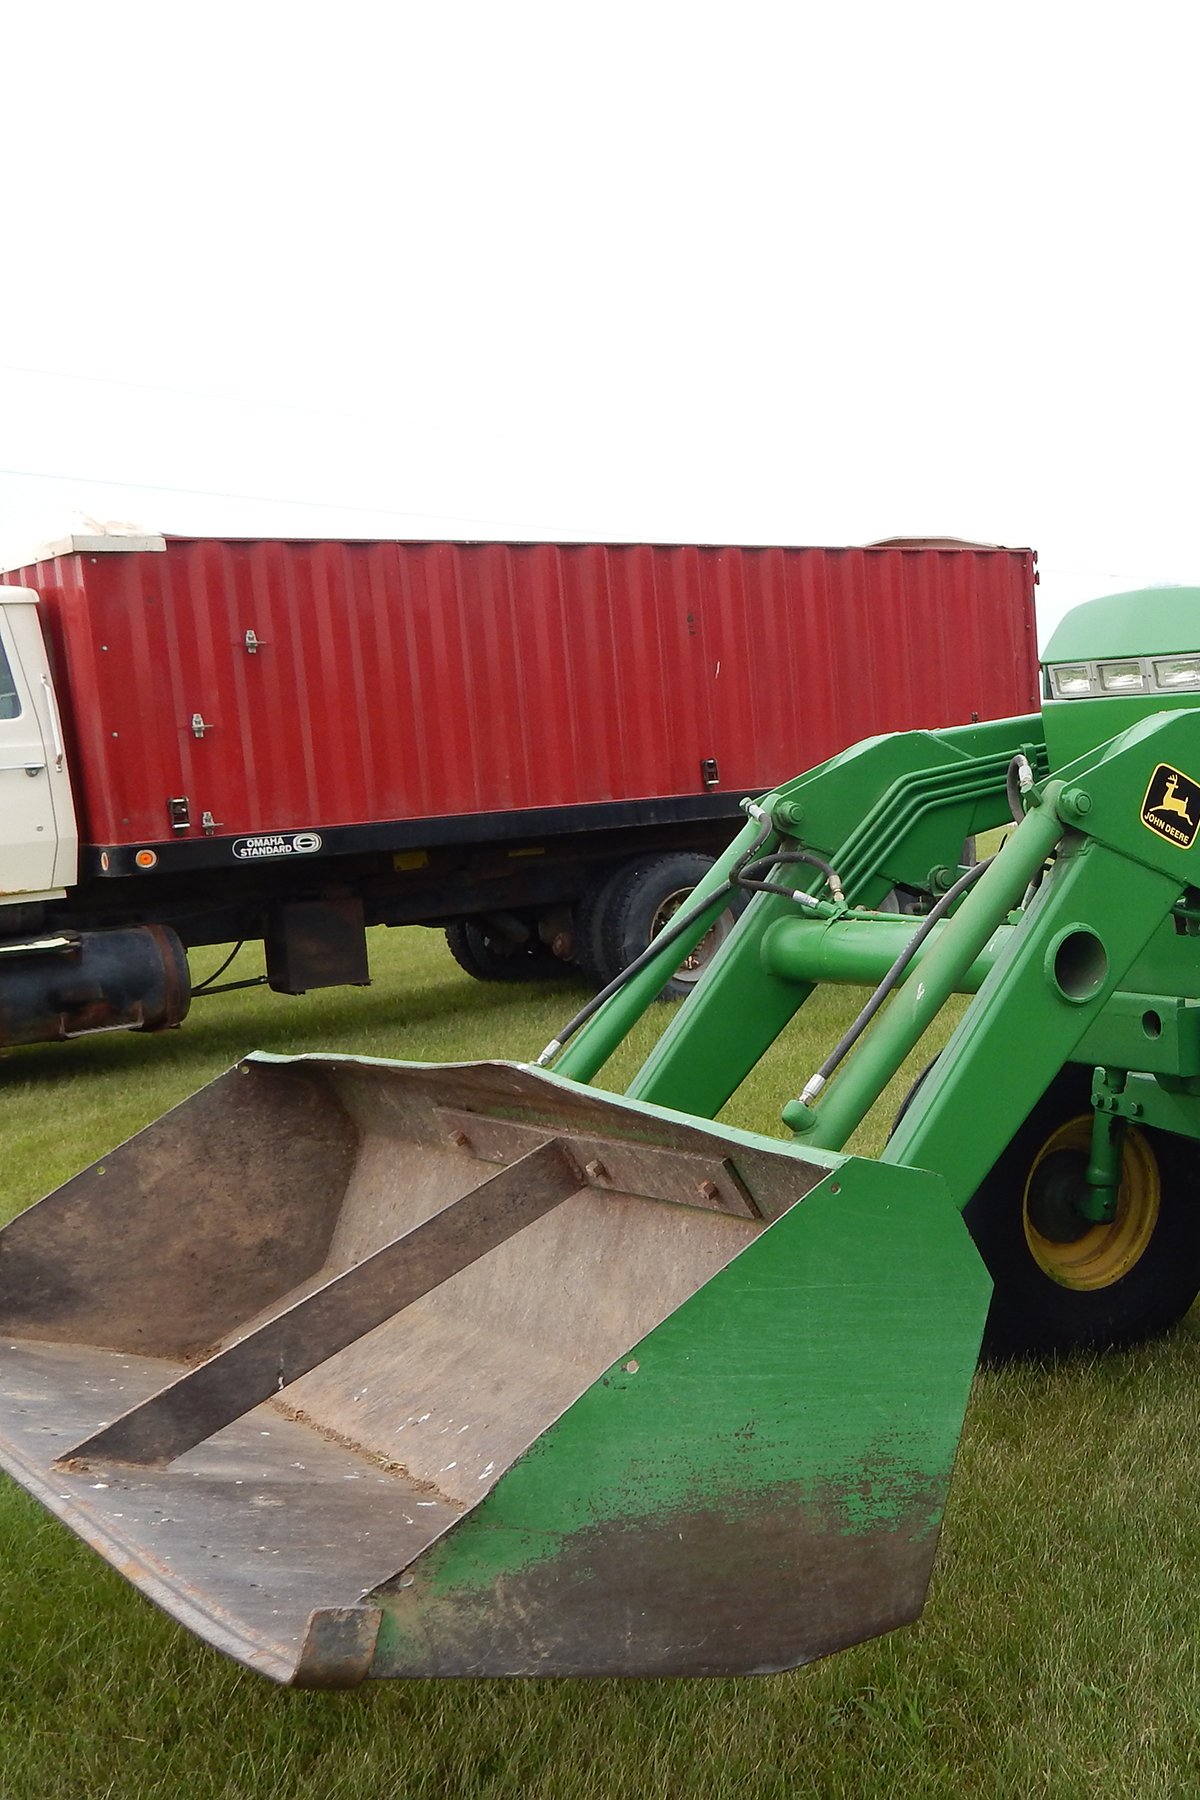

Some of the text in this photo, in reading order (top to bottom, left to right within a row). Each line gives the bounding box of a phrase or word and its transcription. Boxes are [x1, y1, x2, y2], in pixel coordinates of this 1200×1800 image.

[1144, 812, 1190, 844] JOHN DEERE
[247, 837, 284, 848] OMAHA
[240, 844, 292, 857] STANDARD
